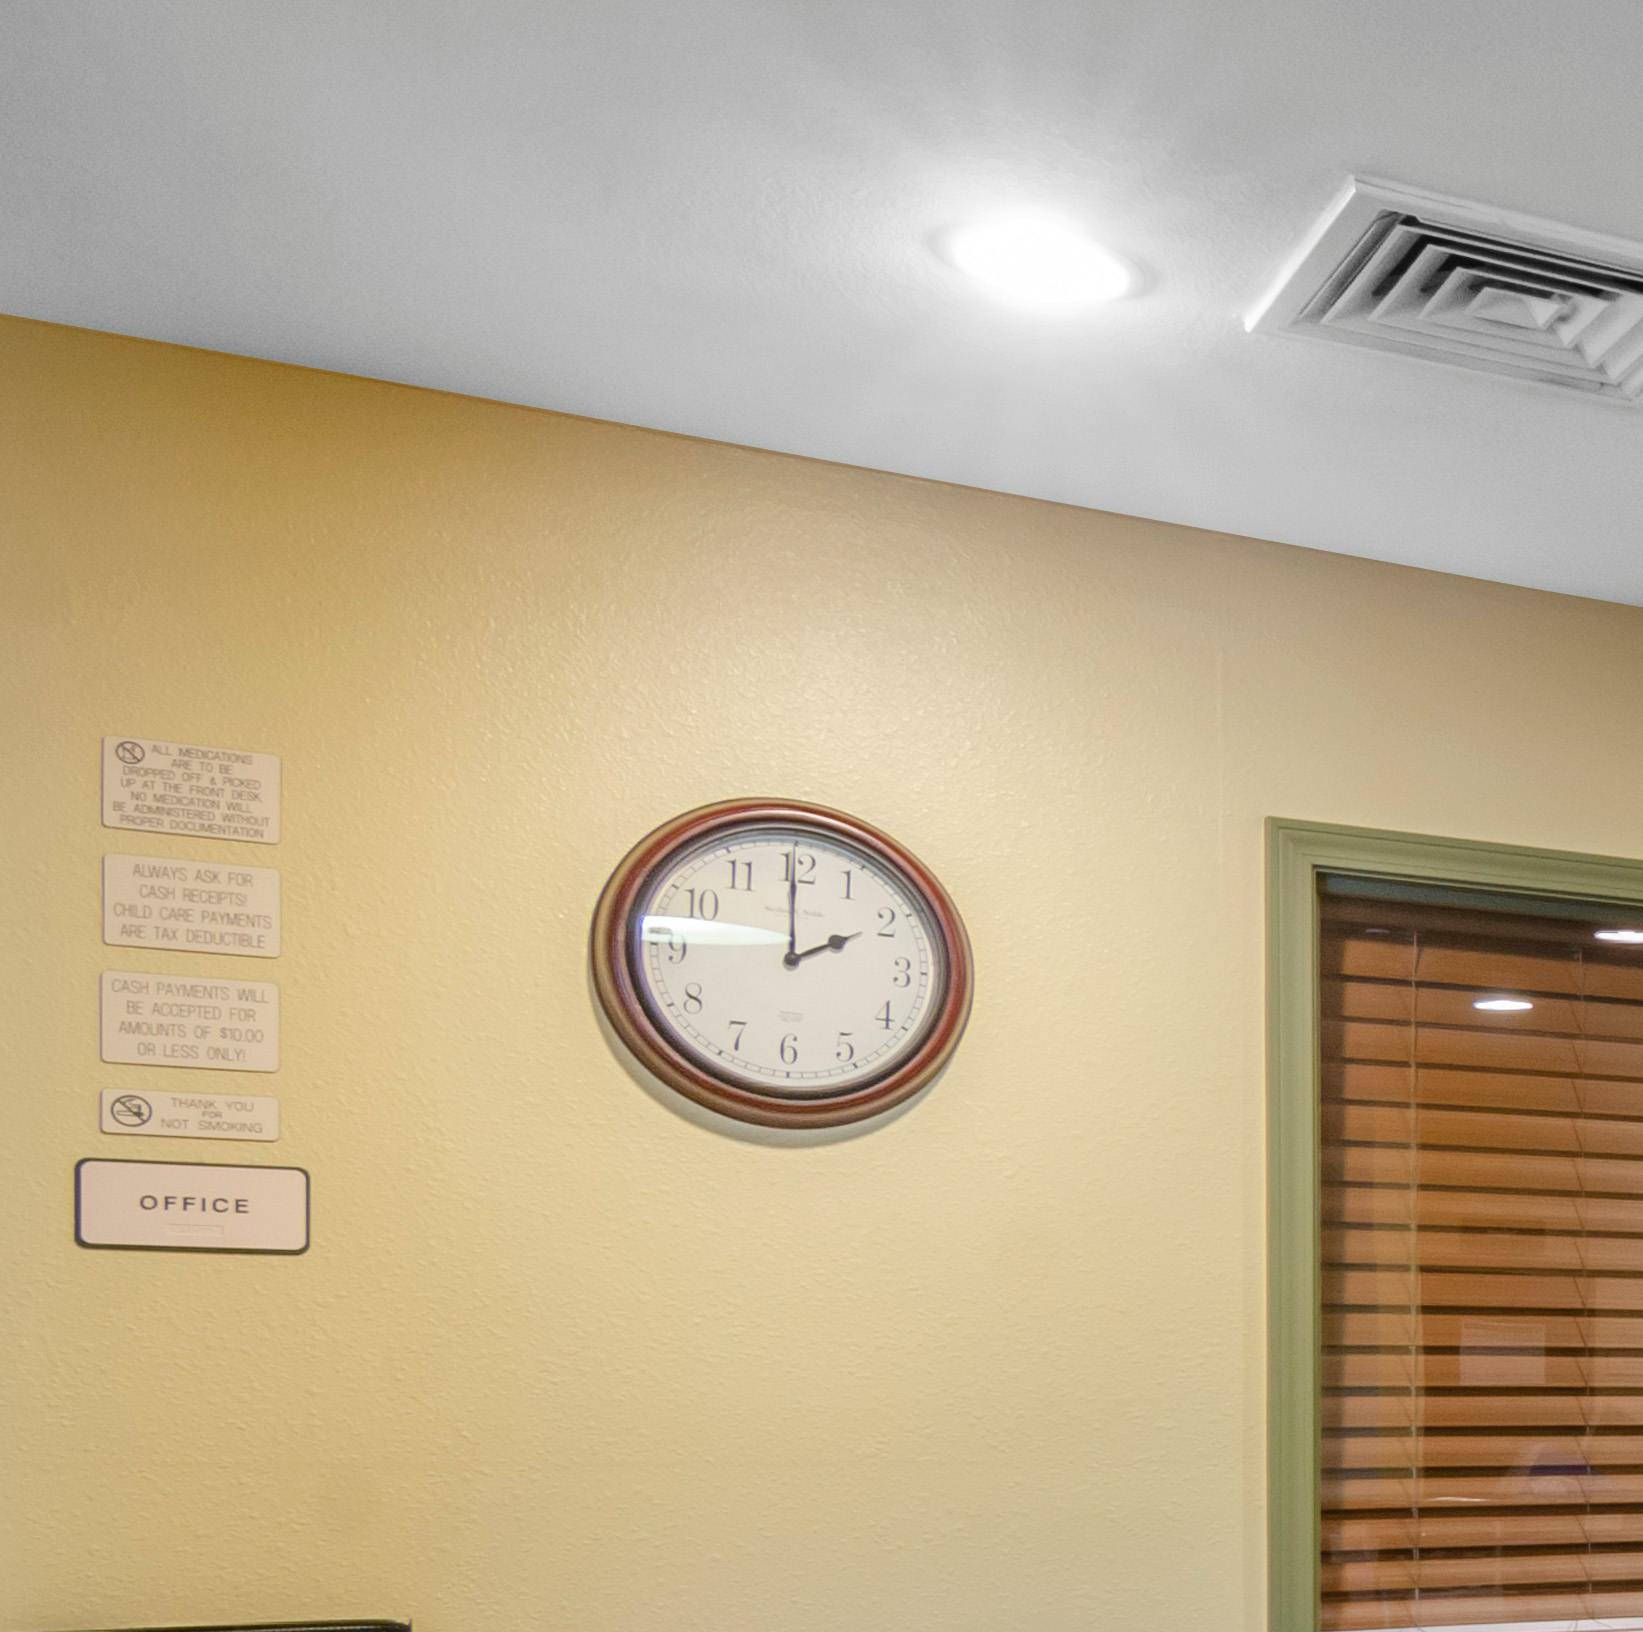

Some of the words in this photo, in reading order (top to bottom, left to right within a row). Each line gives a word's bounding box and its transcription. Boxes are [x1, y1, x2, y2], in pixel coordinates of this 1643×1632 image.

[151, 744, 171, 756] ALL
[178, 748, 253, 765] MEDICATIONS
[171, 759, 192, 771] ARE
[200, 761, 214, 773] TO
[219, 763, 232, 775] BE
[120, 778, 136, 788] UP
[142, 780, 155, 790] AT
[163, 782, 183, 794] THE
[189, 785, 225, 798] FRONT
[122, 766, 176, 781] DROPPED
[182, 772, 203, 782] OFF
[210, 777, 217, 786] &
[222, 778, 262, 790] PICKED
[112, 801, 128, 812] BE
[133, 804, 216, 821] ADMINISTERED
[221, 815, 271, 828] WITHOUT
[130, 791, 147, 801] NO
[153, 793, 220, 810] MEDICATION
[225, 801, 253, 813] WILL
[119, 815, 165, 829] PROPER
[169, 819, 264, 839] DOCUMENTATION
[132, 863, 188, 882] ALWAYS
[194, 869, 221, 884] ASK
[227, 872, 254, 888] FOR
[724, 859, 753, 892] 11
[777, 851, 817, 885] 12
[138, 884, 176, 900] CASH
[840, 869, 857, 901] 1
[112, 902, 153, 919] CHILD
[159, 907, 194, 923] CARE
[201, 910, 273, 930] PAYMENTS
[684, 888, 719, 921] 10
[877, 906, 896, 938] 2
[120, 923, 146, 939] ARE
[153, 926, 179, 941] TAX
[185, 928, 265, 949] DEDUCTIBLE
[667, 932, 687, 964] 9
[893, 957, 911, 988] 3
[111, 978, 150, 995] CASH
[156, 981, 230, 1001] PAYMENTS
[236, 988, 270, 1004] WILL
[683, 982, 703, 1014] 8
[126, 1000, 145, 1015] BE
[151, 1002, 222, 1020] ACCEPTED
[228, 1007, 257, 1022] FOR
[875, 1000, 896, 1030] 4
[118, 1020, 187, 1039] AMOUNTS
[193, 1025, 212, 1039] OF
[219, 1026, 265, 1043] $10.00
[728, 1020, 748, 1051] 7
[136, 1042, 156, 1056] OR
[163, 1044, 199, 1059] LESS
[206, 1046, 247, 1062] ONLY!
[779, 1033, 798, 1065] 6
[836, 1031, 855, 1062] 5
[170, 1097, 218, 1110] THANK
[225, 1101, 255, 1113] YOU
[201, 1110, 223, 1119] FOR
[160, 1118, 190, 1129] NOT
[198, 1120, 263, 1134] SMOKING
[139, 1194, 249, 1214] OFFICE
